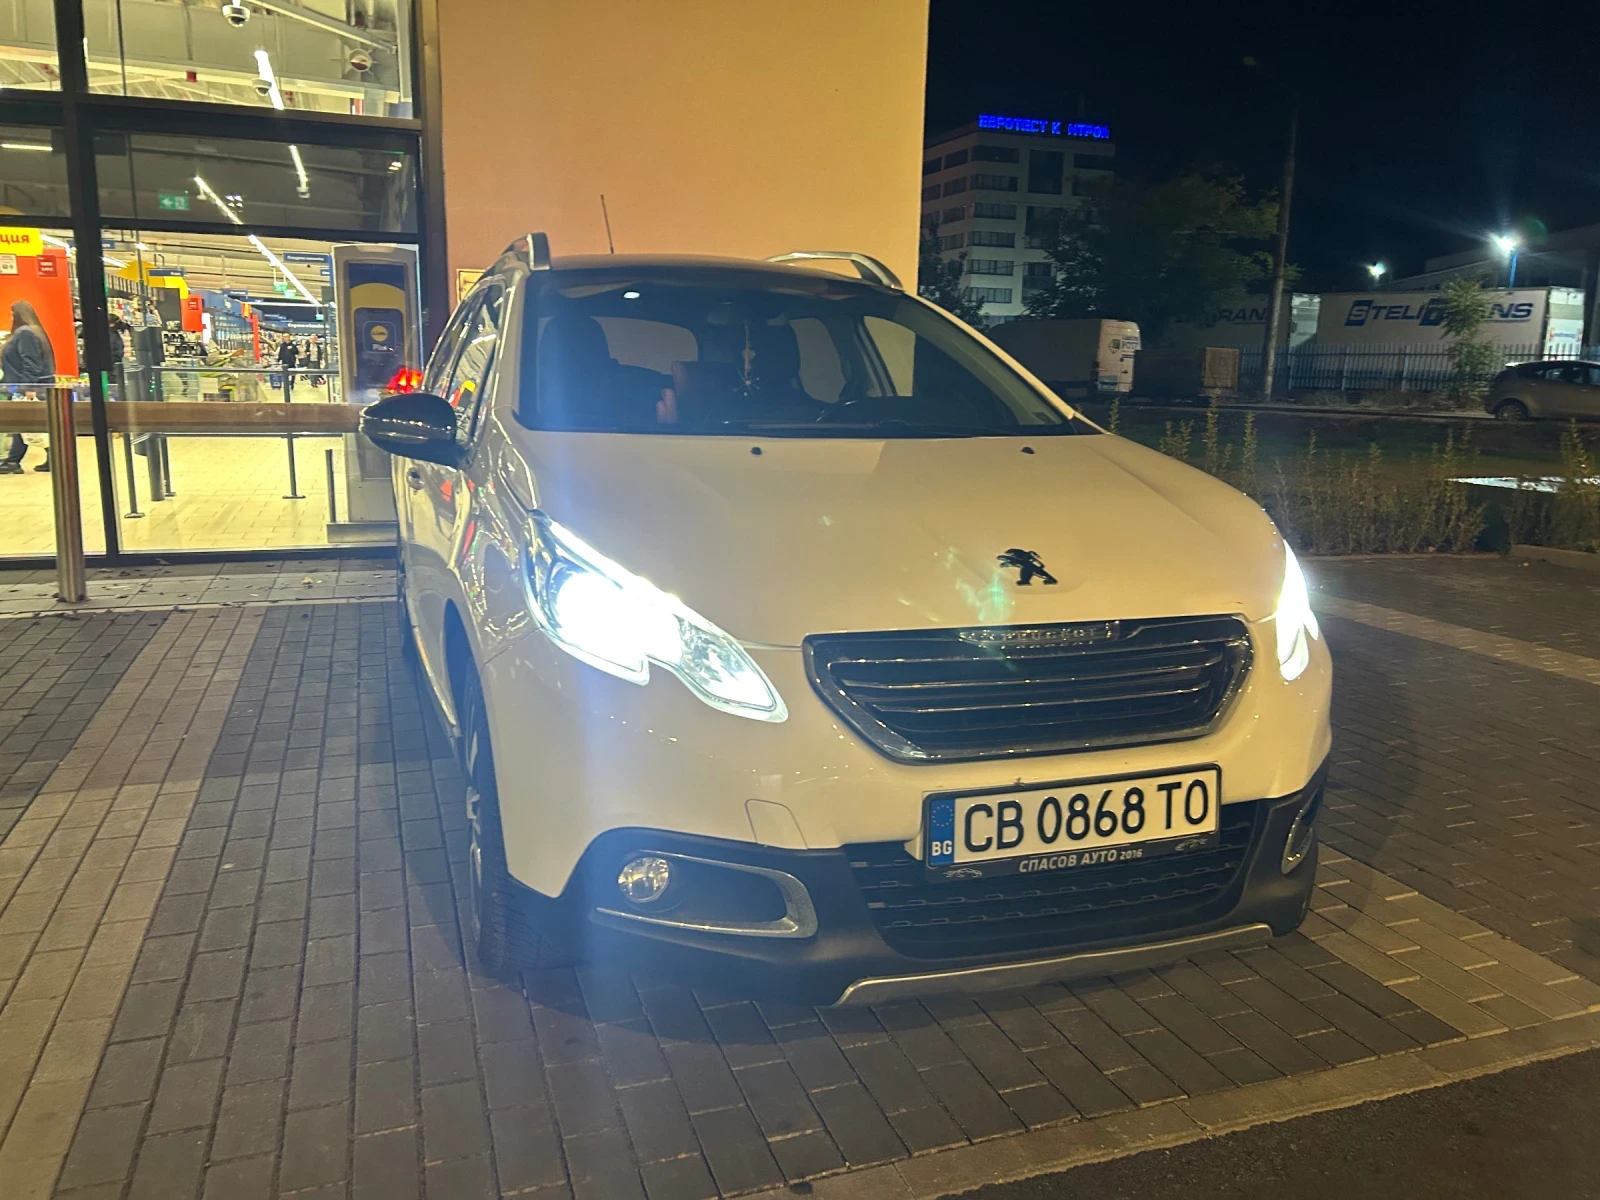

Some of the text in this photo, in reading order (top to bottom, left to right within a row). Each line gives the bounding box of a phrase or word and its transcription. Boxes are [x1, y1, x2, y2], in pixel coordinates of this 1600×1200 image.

[979, 114, 1109, 138] ЕВРОТЕСТ КНТРОЛ
[931, 840, 952, 856] BG
[1037, 786, 1145, 844] 0868
[1019, 849, 1143, 873] СПАСОВ АУТО 2016
